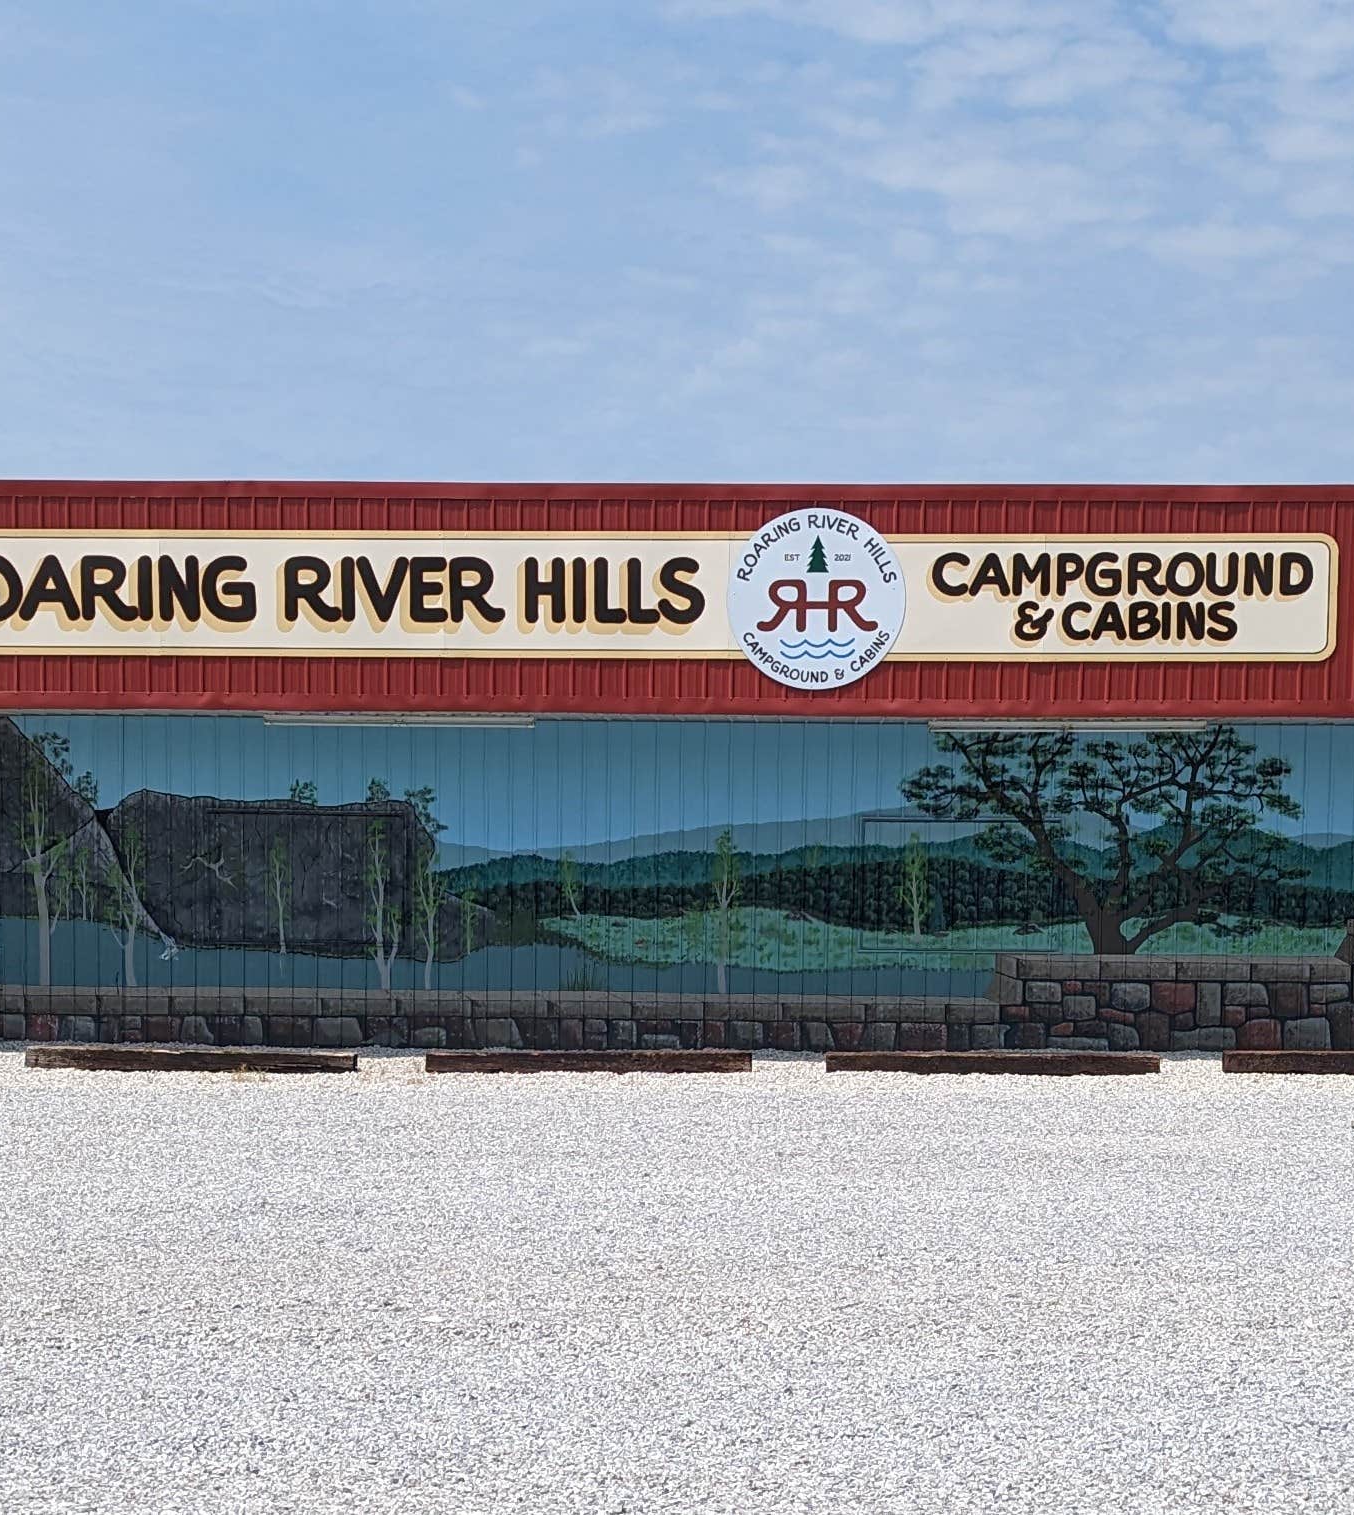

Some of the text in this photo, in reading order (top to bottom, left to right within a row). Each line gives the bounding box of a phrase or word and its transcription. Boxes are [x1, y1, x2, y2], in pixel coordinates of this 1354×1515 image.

[736, 514, 897, 584] ROARING RIVER HILLS
[784, 553, 801, 562] EST
[283, 555, 506, 624] RIVER
[523, 556, 707, 625] HILLS
[931, 552, 1314, 597] CAMPGROUND
[1014, 600, 1239, 642] & CABINS
[743, 630, 891, 683] CAMPGROUND & CABINS
